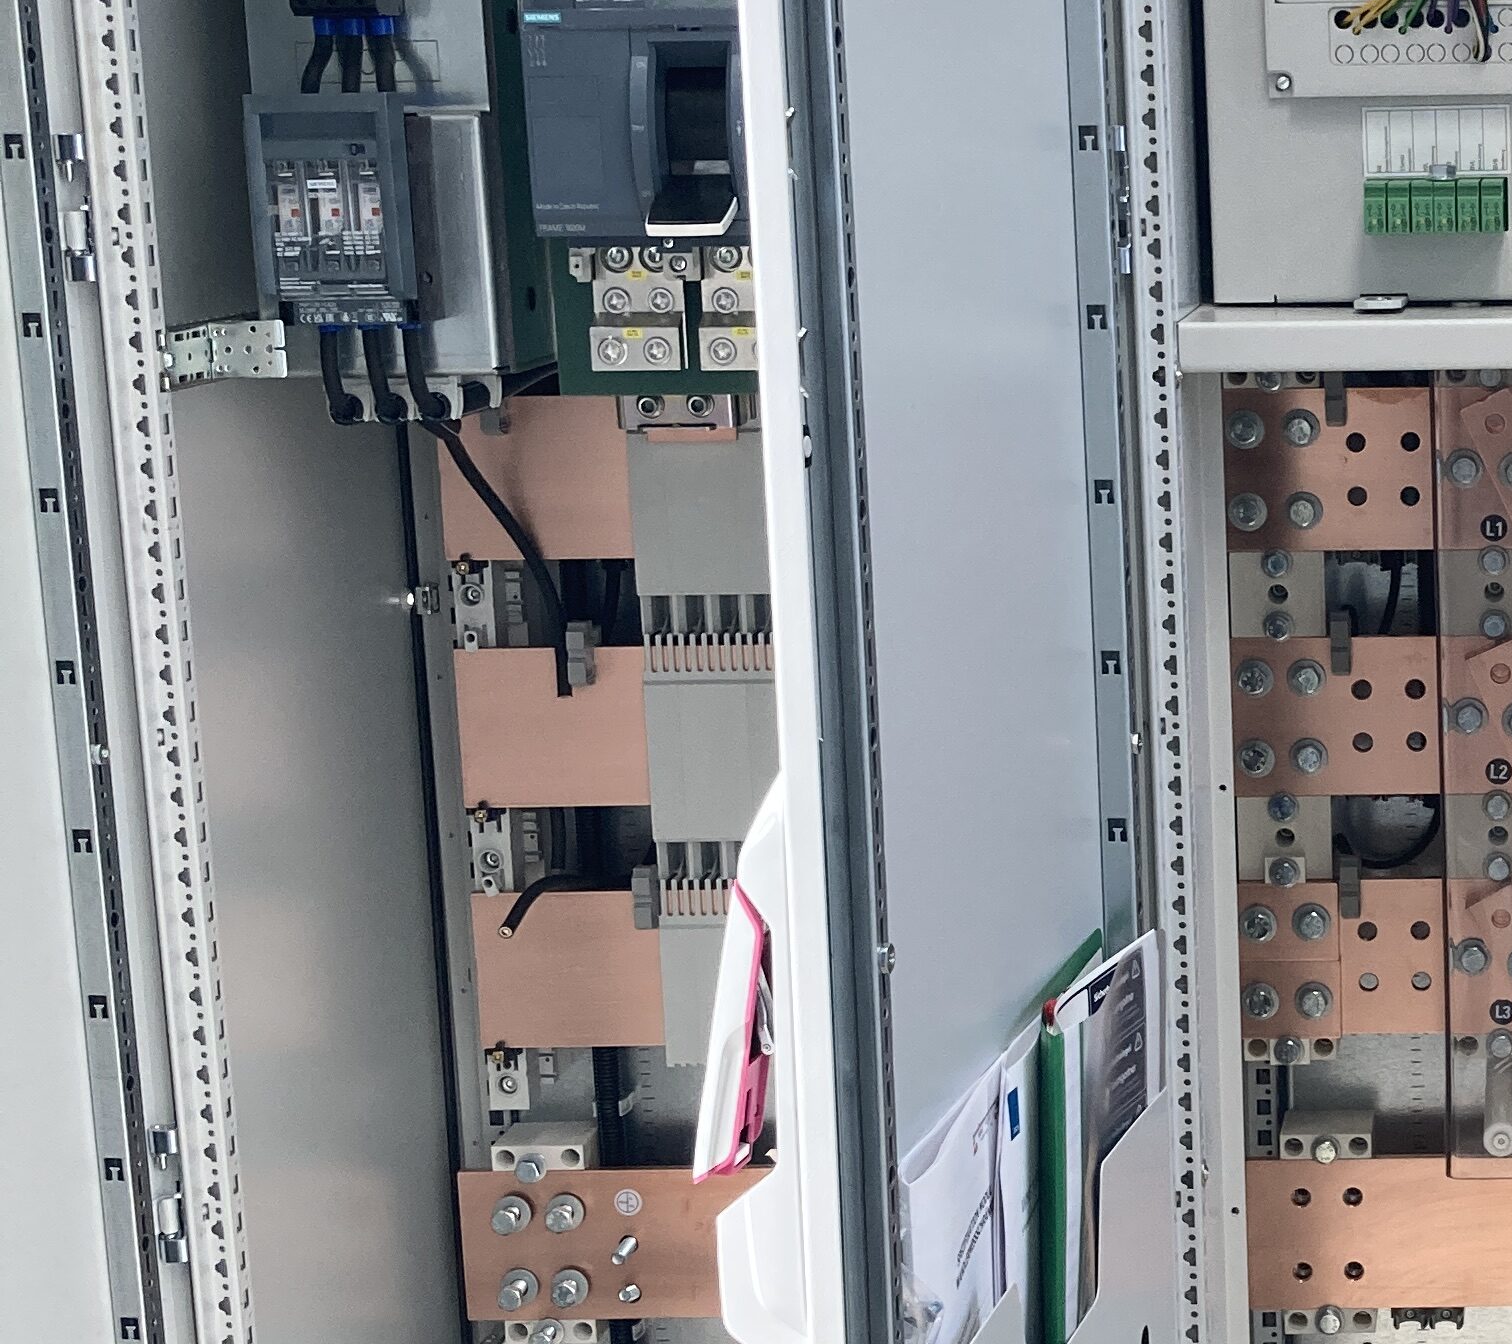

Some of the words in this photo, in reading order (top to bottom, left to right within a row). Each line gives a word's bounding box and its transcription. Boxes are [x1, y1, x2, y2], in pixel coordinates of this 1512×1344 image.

[1485, 522, 1503, 537] L1
[1489, 764, 1508, 780] L2
[1495, 1005, 1512, 1019] L3
